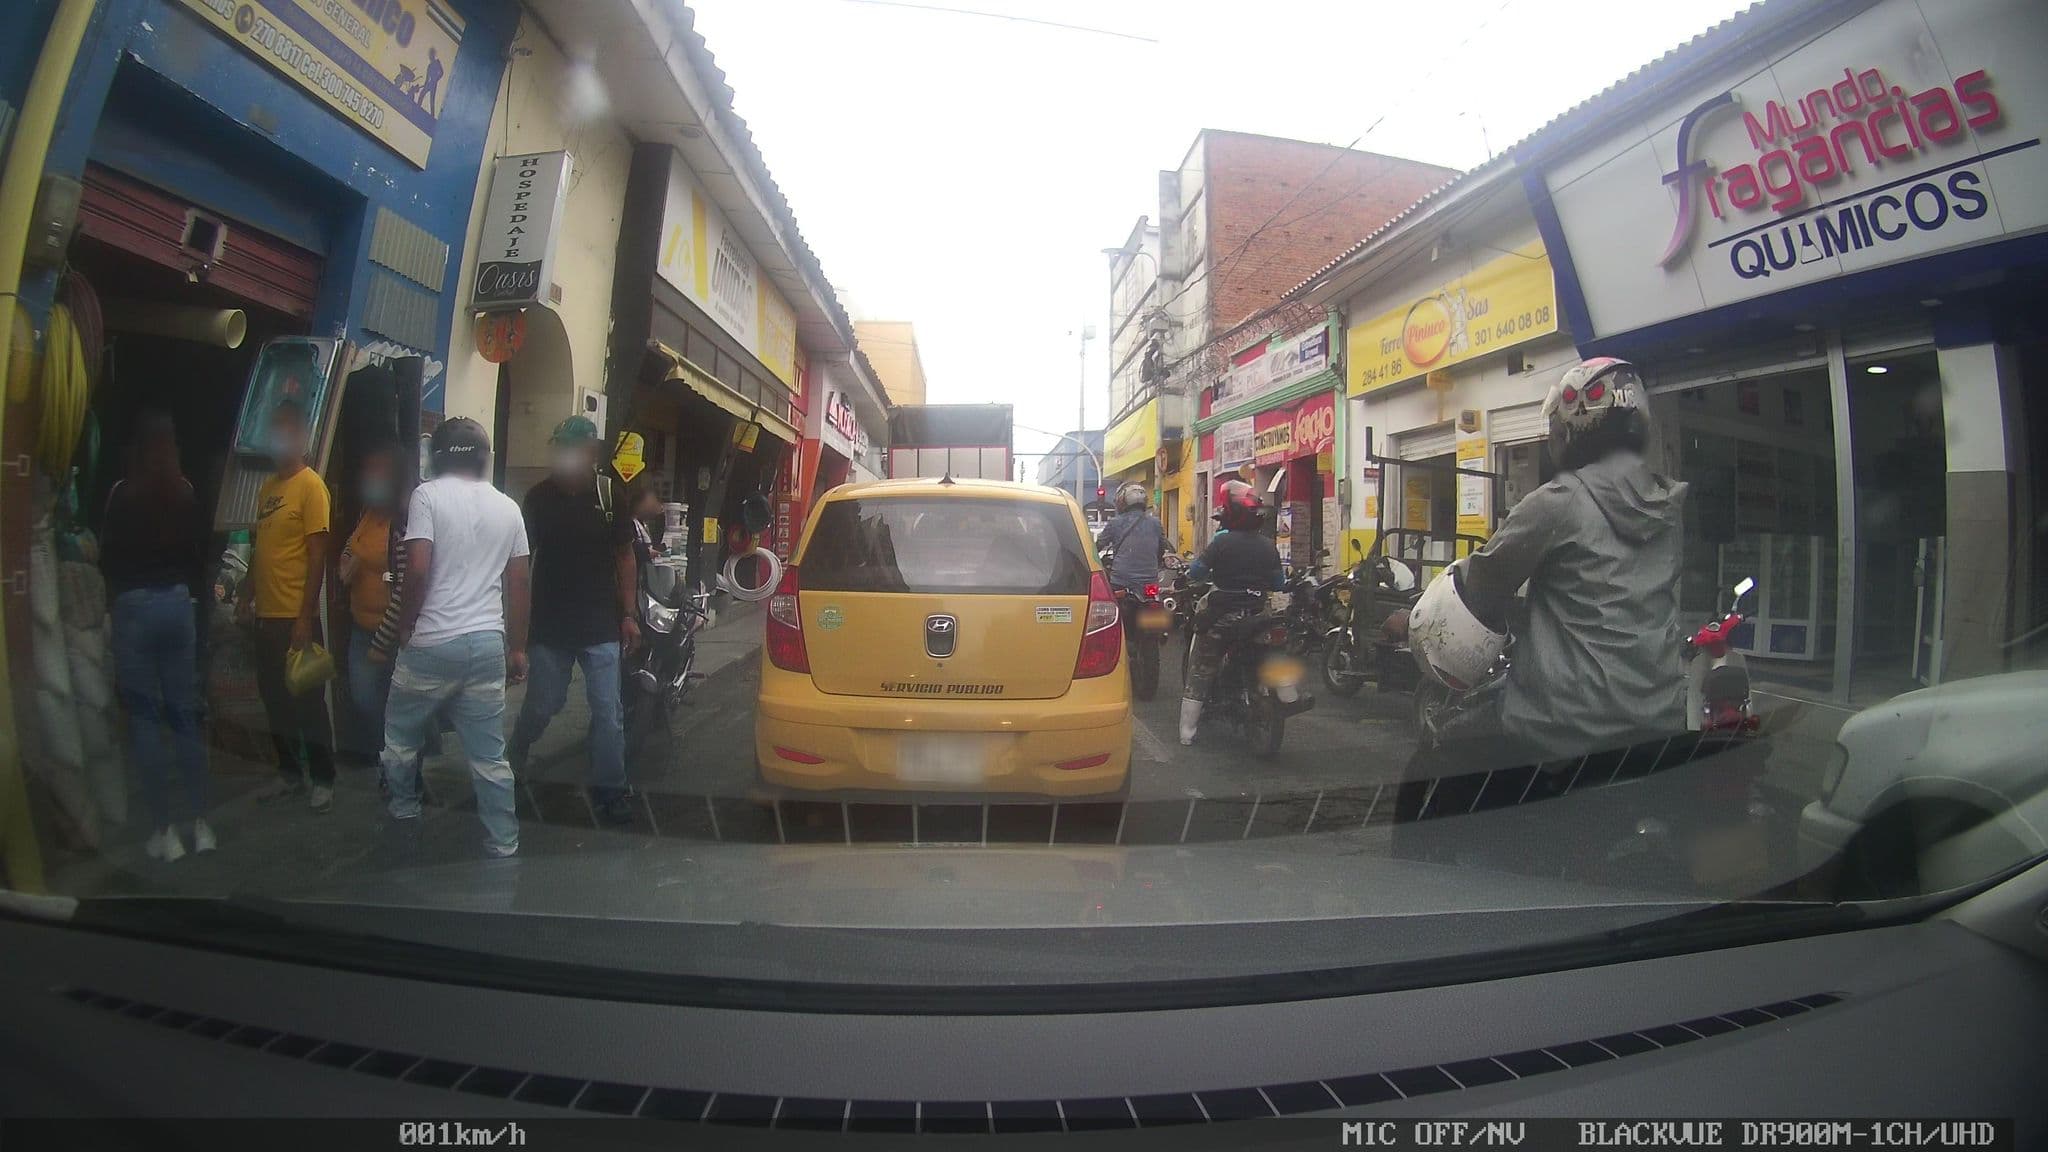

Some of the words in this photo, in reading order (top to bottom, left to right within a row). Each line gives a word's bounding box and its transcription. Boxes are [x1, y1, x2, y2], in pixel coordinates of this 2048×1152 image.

[324, 0, 371, 48] GENERAL
[251, 17, 276, 50] 270
[340, 82, 362, 112] 745
[359, 97, 384, 129] 8270
[1742, 67, 1888, 149] Mundo
[1657, 69, 2000, 269] fragancias
[504, 157, 540, 258] HOSPEDAJE
[478, 263, 535, 294] Oasis
[1467, 297, 1489, 321] Sas
[1474, 328, 1492, 347] 301
[1496, 319, 1516, 339] 640
[1518, 312, 1532, 332] 08
[1535, 305, 1550, 326] 08
[1379, 336, 1402, 356] Ferro
[1408, 319, 1445, 343] Pintuco
[1361, 368, 1378, 387] 284
[1378, 364, 1389, 381] 41
[1391, 359, 1402, 376] 86
[449, 445, 475, 453] thor
[880, 681, 943, 694] SERVICIO
[946, 683, 1004, 695] PUBLICO
